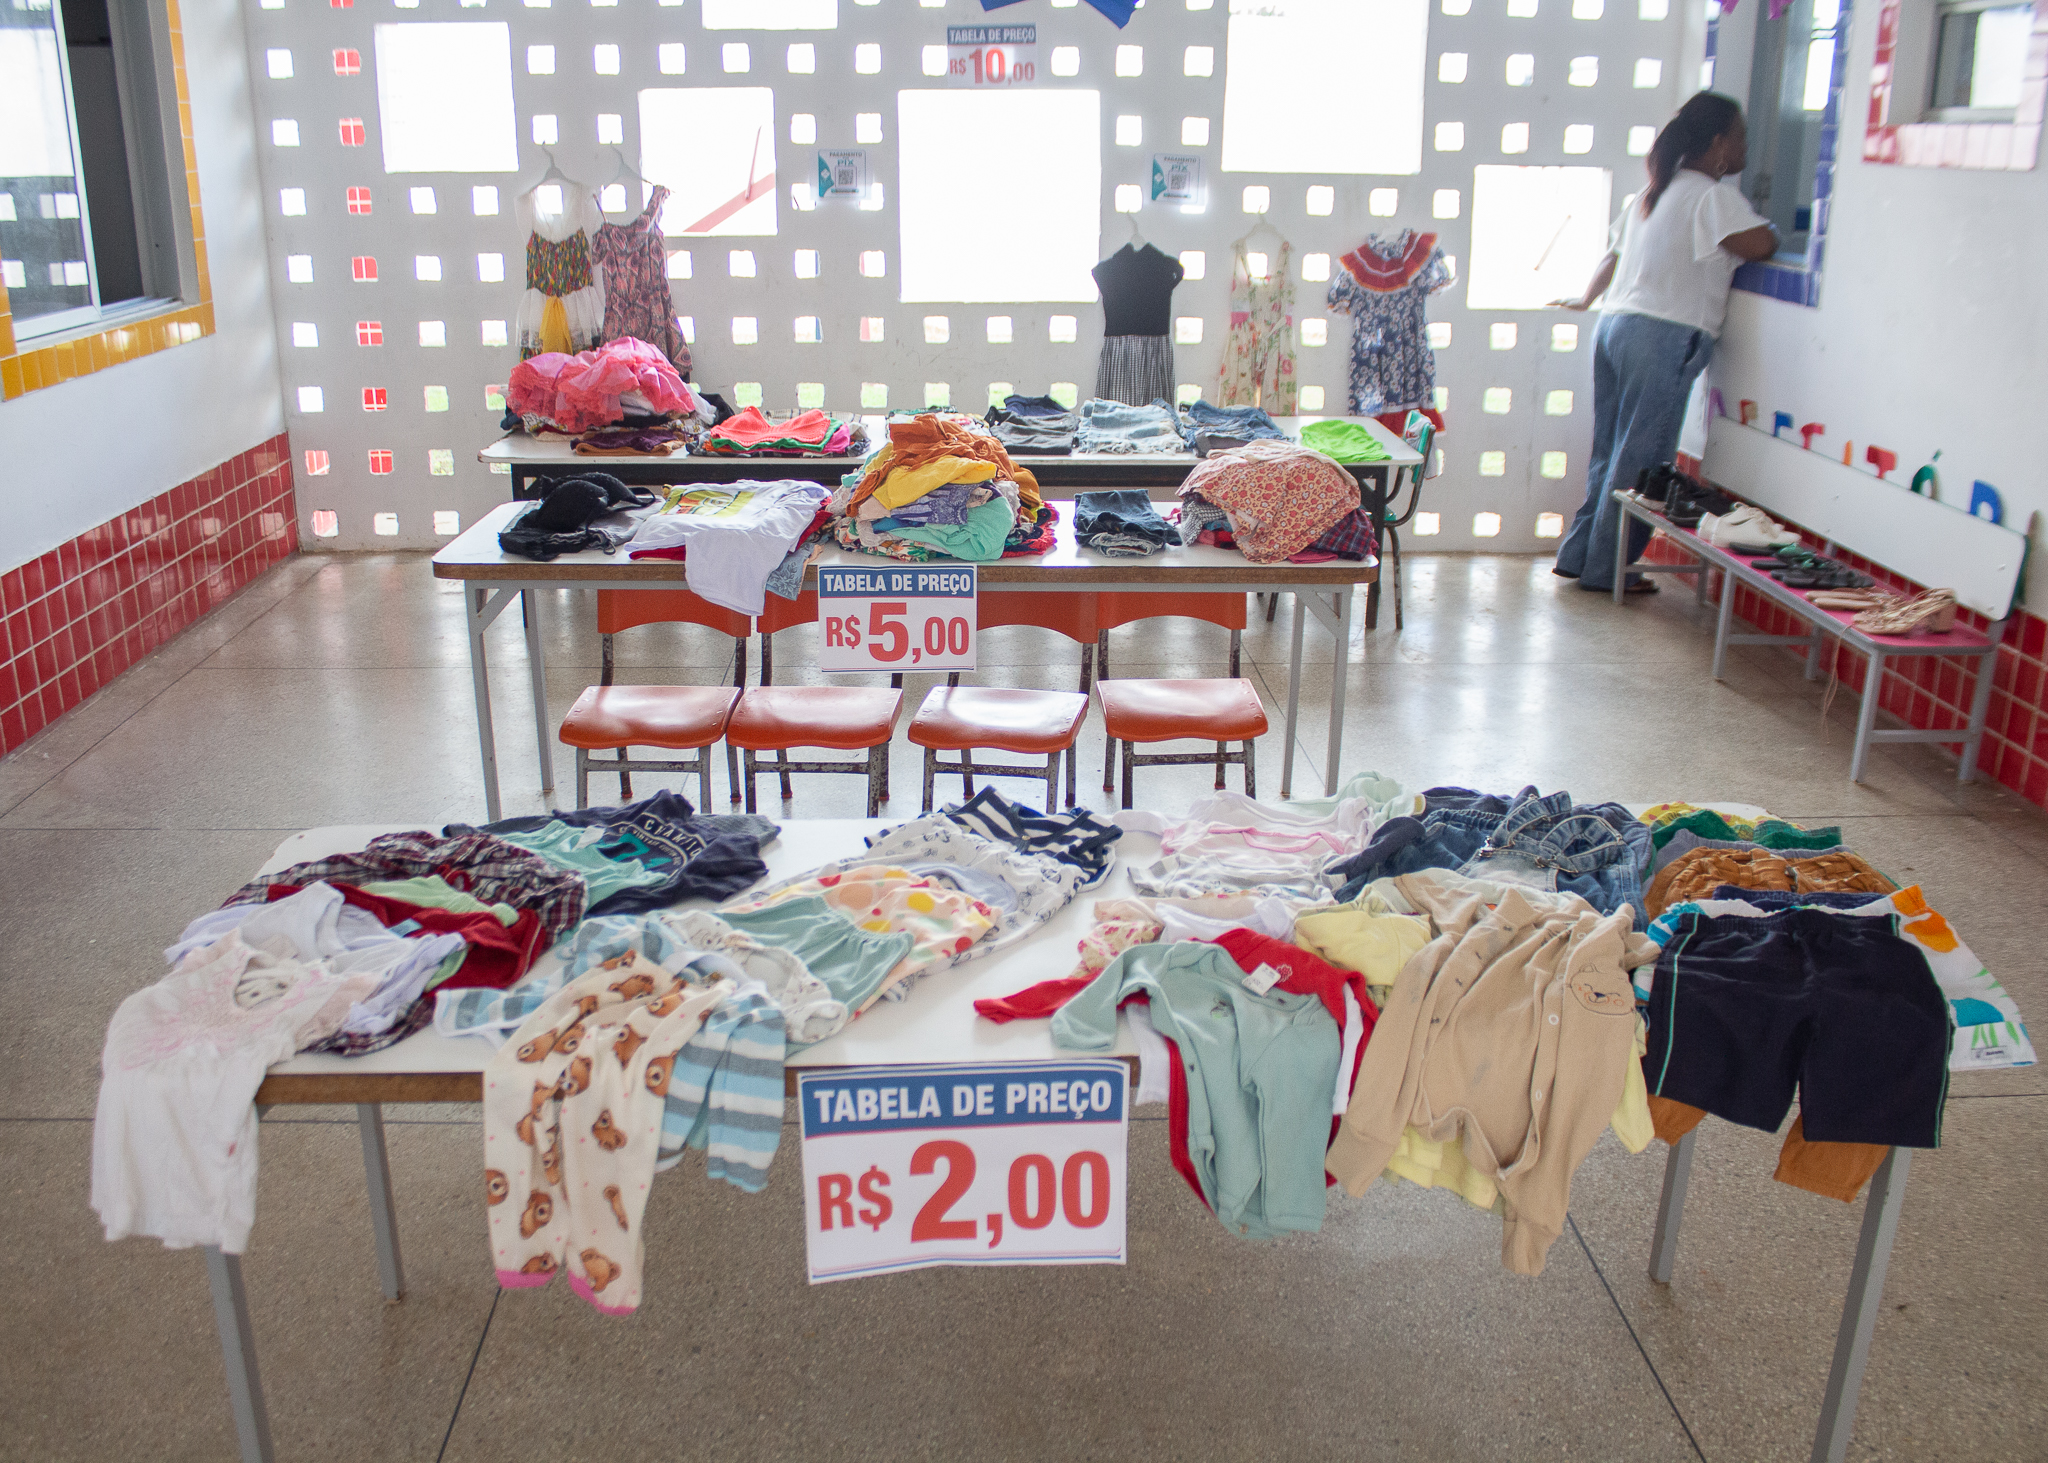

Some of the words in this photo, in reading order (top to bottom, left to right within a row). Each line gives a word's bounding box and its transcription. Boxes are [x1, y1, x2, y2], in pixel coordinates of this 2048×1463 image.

[949, 28, 986, 43] TABELA
[988, 28, 1001, 42] DE
[1003, 27, 1035, 43] PREÇO
[949, 57, 967, 76] R$
[968, 47, 1036, 86] 10,00
[837, 158, 854, 166] PIX
[823, 574, 887, 592] TABELA
[891, 573, 913, 592] DE
[918, 573, 971, 595] PREÇO
[825, 614, 861, 650] R$
[867, 602, 970, 664] 5,00
[813, 1085, 942, 1124] TABELA
[952, 1083, 995, 1118] DE
[1005, 1079, 1113, 1120] PREÇO
[817, 1164, 894, 1233] R$
[909, 1138, 1112, 1250] 2,00
